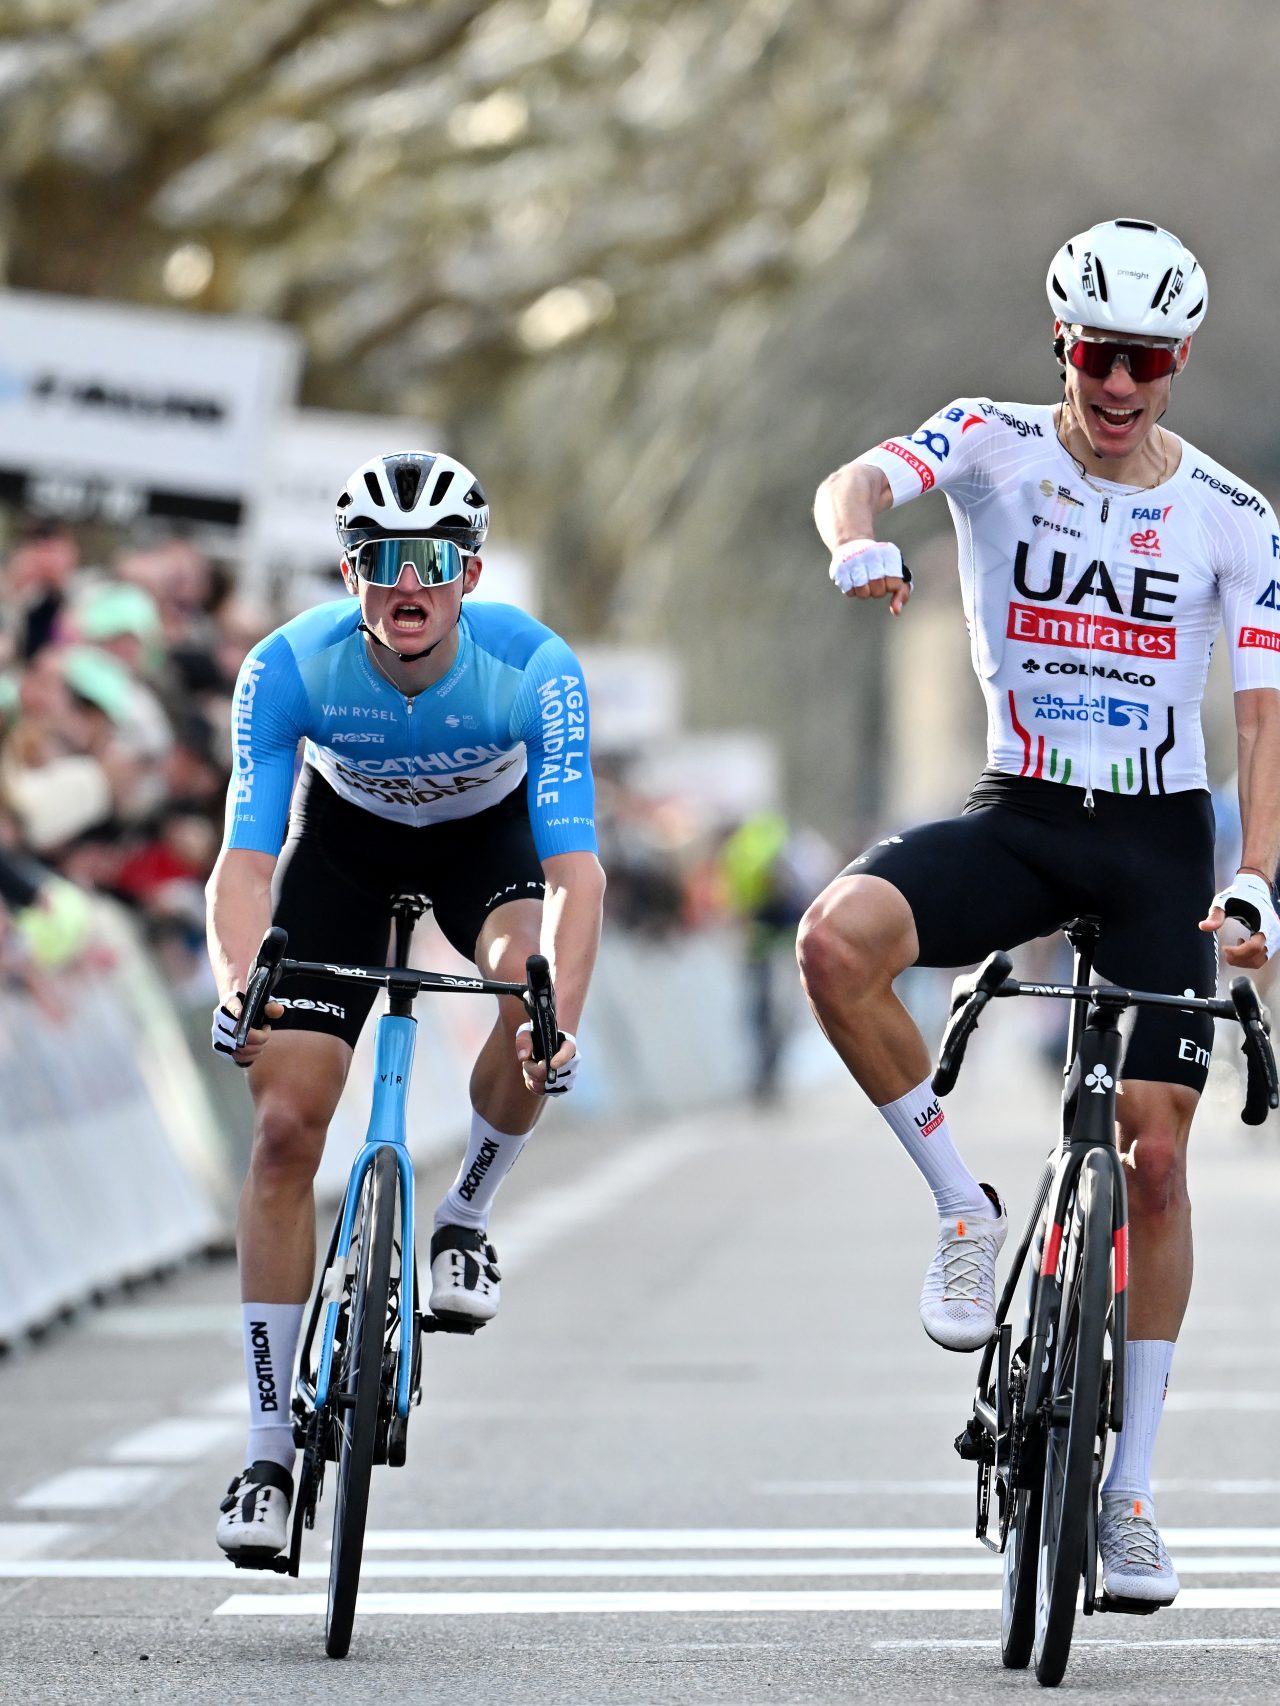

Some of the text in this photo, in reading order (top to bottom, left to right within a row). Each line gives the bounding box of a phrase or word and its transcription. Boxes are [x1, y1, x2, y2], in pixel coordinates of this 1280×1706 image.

[1081, 251, 1098, 302] MET
[1160, 264, 1185, 316] MET
[977, 403, 1044, 438] presight
[1190, 467, 1268, 519] presight
[1013, 540, 1180, 623] UAE
[1013, 608, 1173, 655] Emirates
[1044, 661, 1156, 687] COLNAGO
[234, 658, 266, 803] DECATHLON
[321, 703, 398, 722] VAN RYSEL
[561, 674, 585, 784] AG2R LA
[1034, 707, 1105, 723] ADNOC
[536, 677, 565, 808] MONDIALE
[546, 817, 570, 827] VAN
[913, 1097, 942, 1128] UAE
[458, 1136, 500, 1202] DECATHLON
[250, 1321, 279, 1412] DECATHLON
